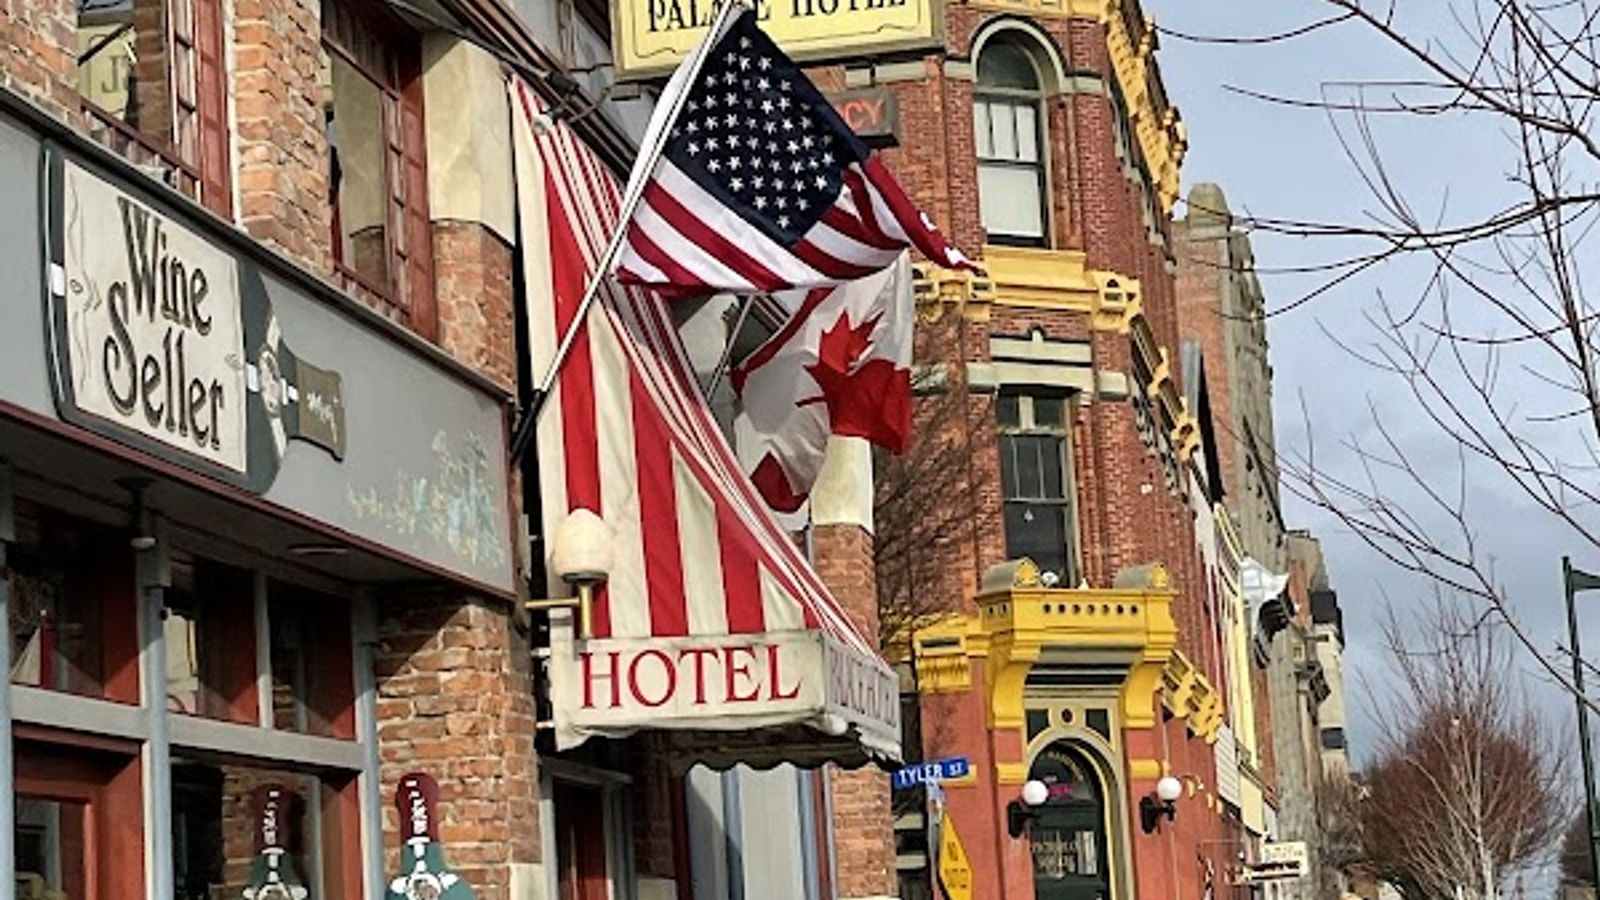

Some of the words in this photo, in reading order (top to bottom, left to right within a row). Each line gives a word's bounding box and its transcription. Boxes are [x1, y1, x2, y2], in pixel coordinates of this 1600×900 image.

[116, 195, 212, 337] Wine
[103, 281, 224, 451] Seller
[578, 644, 801, 710] HOTEL
[898, 763, 943, 785] TYLER
